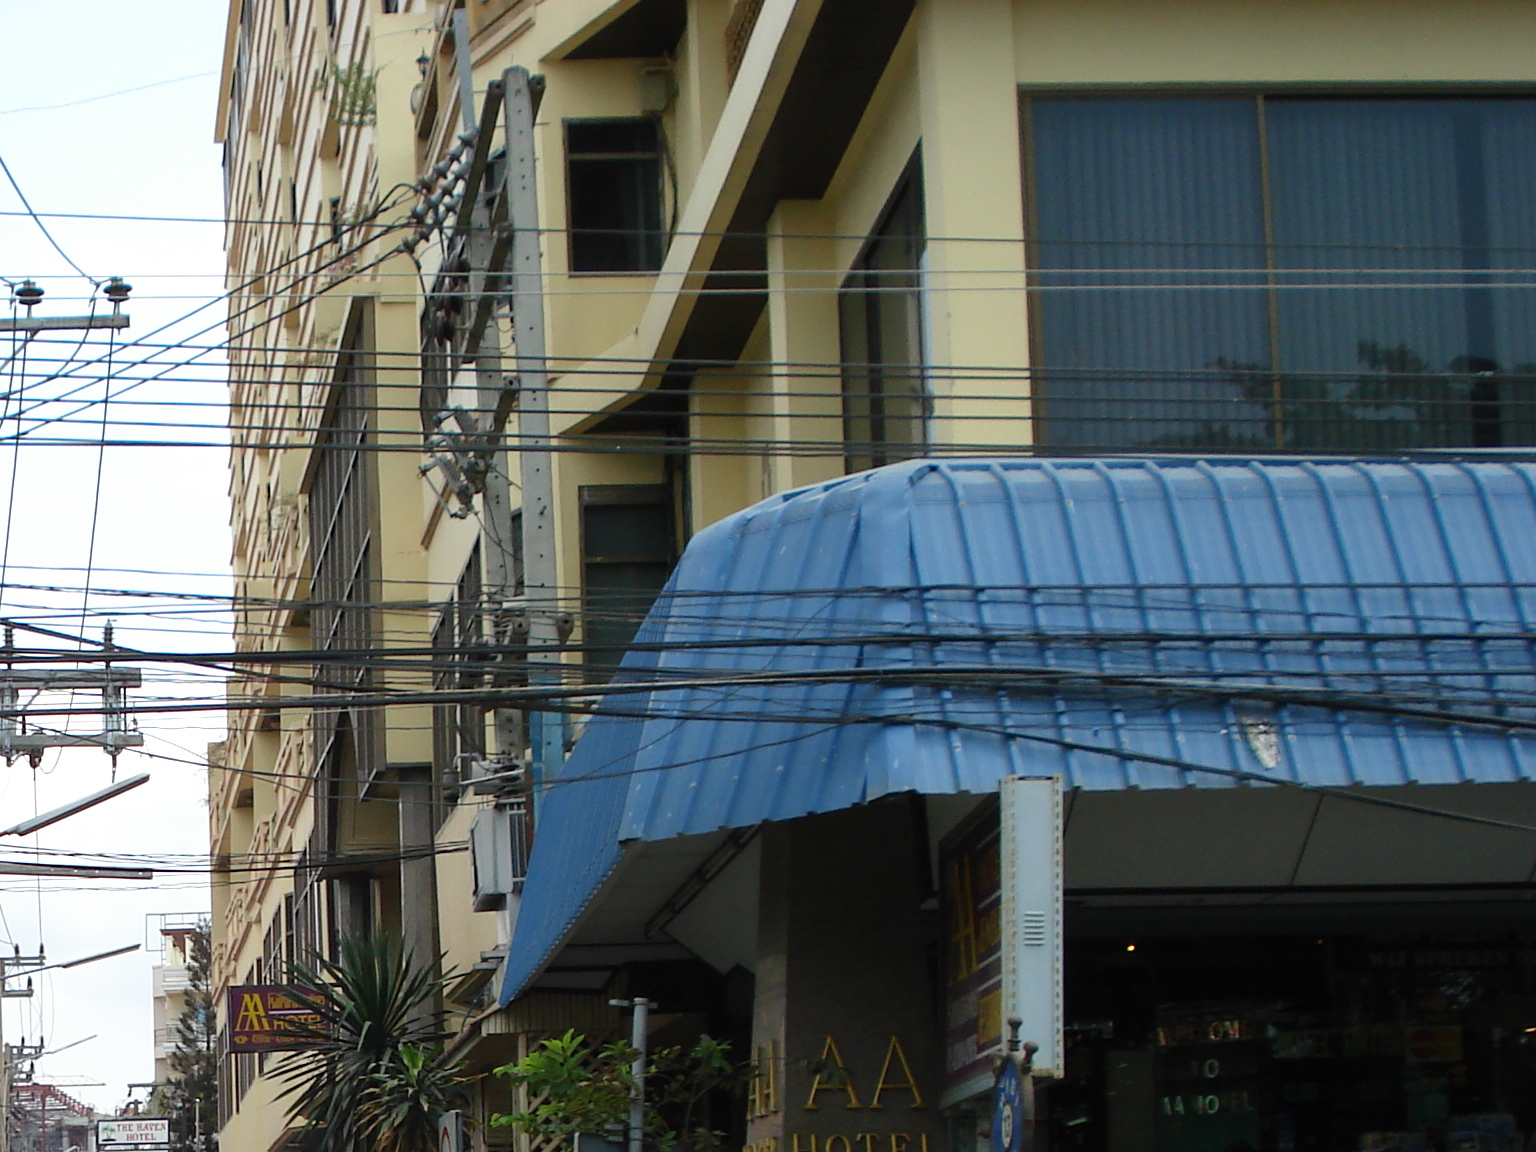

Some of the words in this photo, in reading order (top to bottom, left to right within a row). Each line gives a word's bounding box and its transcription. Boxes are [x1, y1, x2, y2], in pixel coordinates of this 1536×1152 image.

[117, 1123, 134, 1132] THE
[137, 1123, 166, 1132] HAVEN
[126, 1133, 156, 1141] HOTEL
